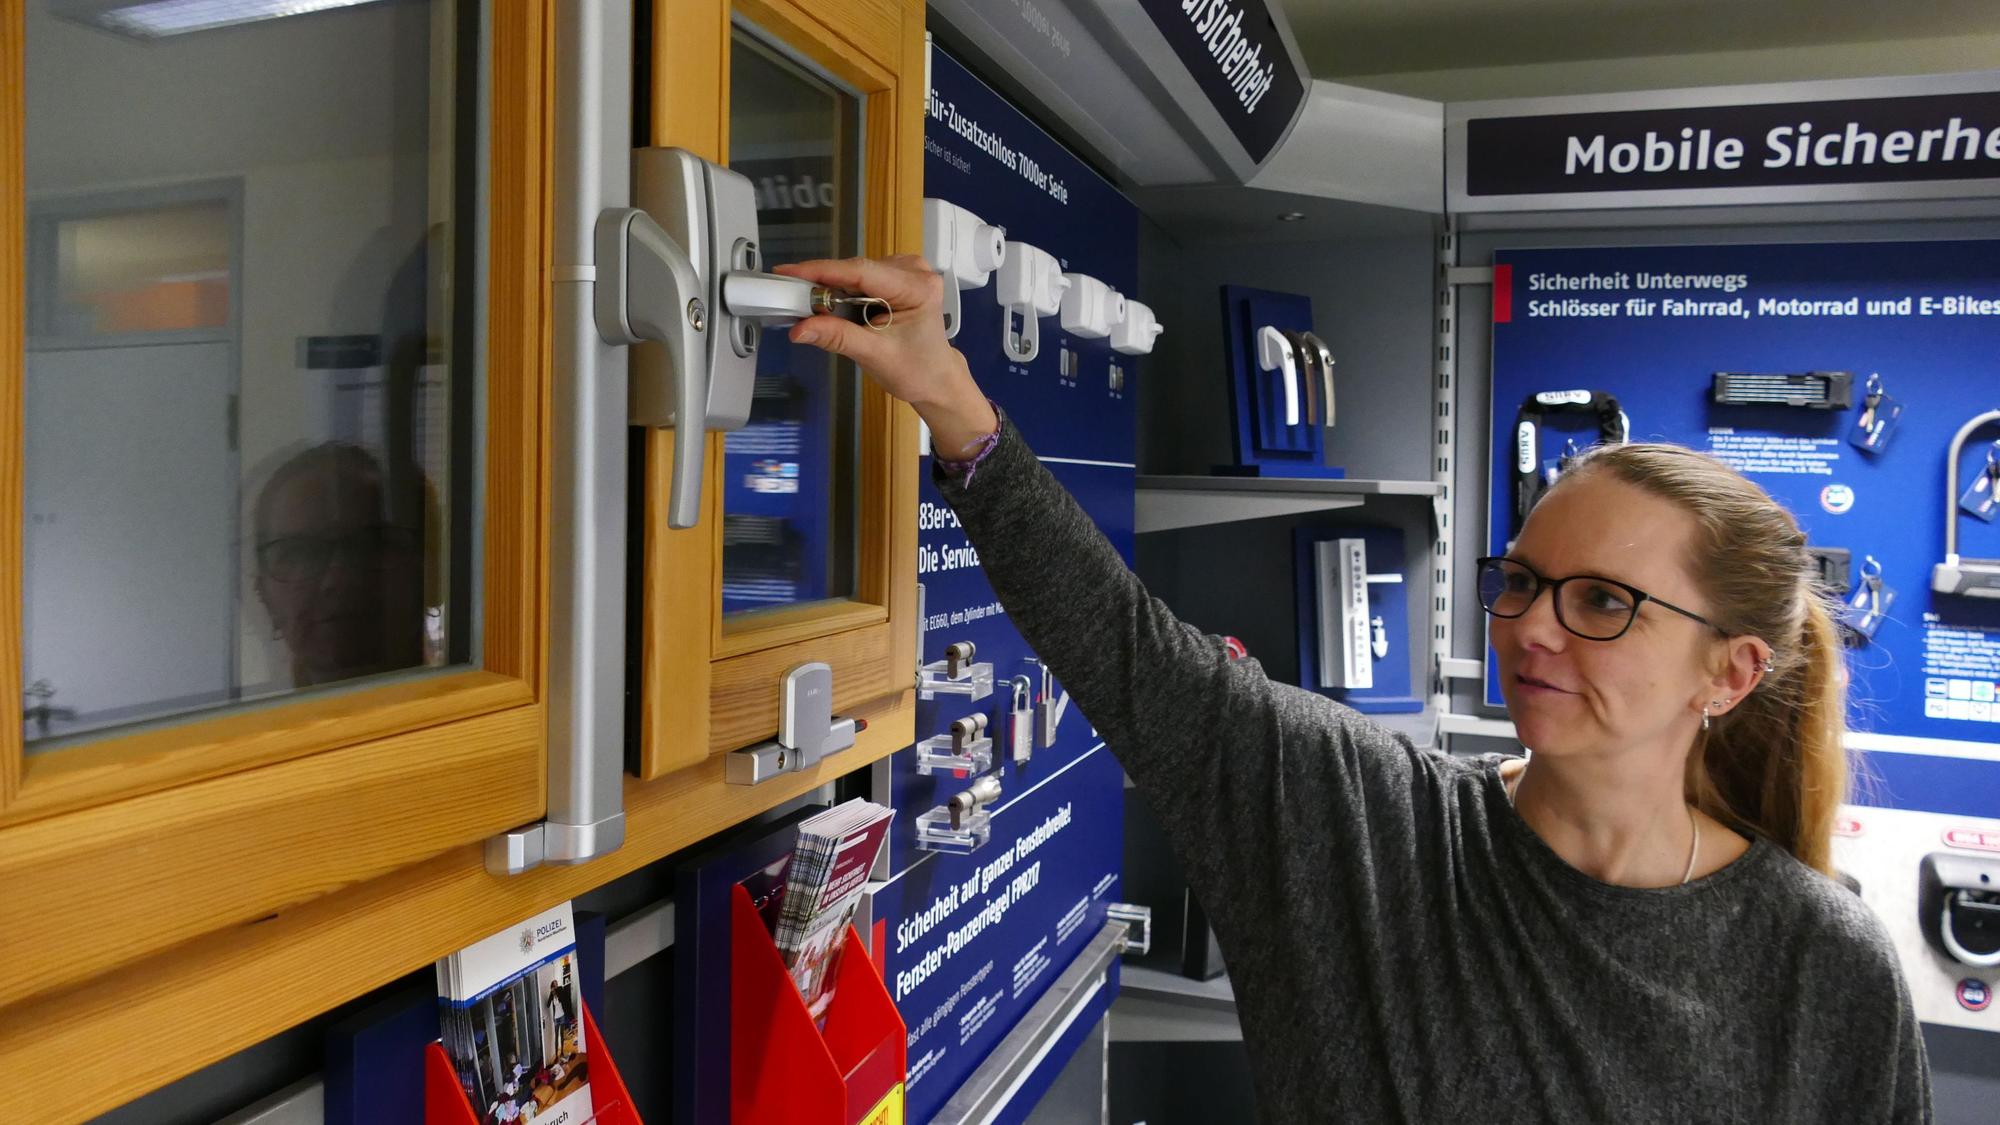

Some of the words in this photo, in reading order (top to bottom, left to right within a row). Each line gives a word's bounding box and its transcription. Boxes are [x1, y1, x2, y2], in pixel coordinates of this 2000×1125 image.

[924, 136, 943, 159] Sicher
[943, 147, 952, 164] ist
[952, 154, 971, 175] sicher!
[931, 88, 1016, 170] ür-Zusatzschloss
[1018, 152, 1047, 191] 7000er
[1048, 174, 1068, 205] Serie
[1565, 127, 1744, 175] Mobile
[1764, 118, 2000, 168] Sicherhe
[1528, 272, 1630, 291] Sicherheit
[1636, 272, 1748, 292] Unterwegs
[1528, 298, 1620, 317] Schlösser
[1626, 298, 1657, 316] für
[1662, 297, 1750, 318] Fahrrad,
[1758, 297, 1858, 316] Motorrad
[1866, 296, 1911, 315] und
[1919, 295, 2000, 315] E-Bikes
[919, 502, 962, 530] 83er-S
[919, 543, 939, 574] Die
[950, 611, 963, 625] dem
[964, 606, 985, 625] Zylinder
[986, 602, 995, 616] mit
[897, 884, 959, 954] Sicherheit
[961, 874, 979, 904] auf
[982, 847, 1015, 895] ganzer
[1016, 802, 1071, 864] Fensterbreite!
[536, 918, 562, 938] POLIZEI
[896, 895, 1009, 1002] Fenster-Panzerriegel
[1011, 861, 1040, 904] FPR217
